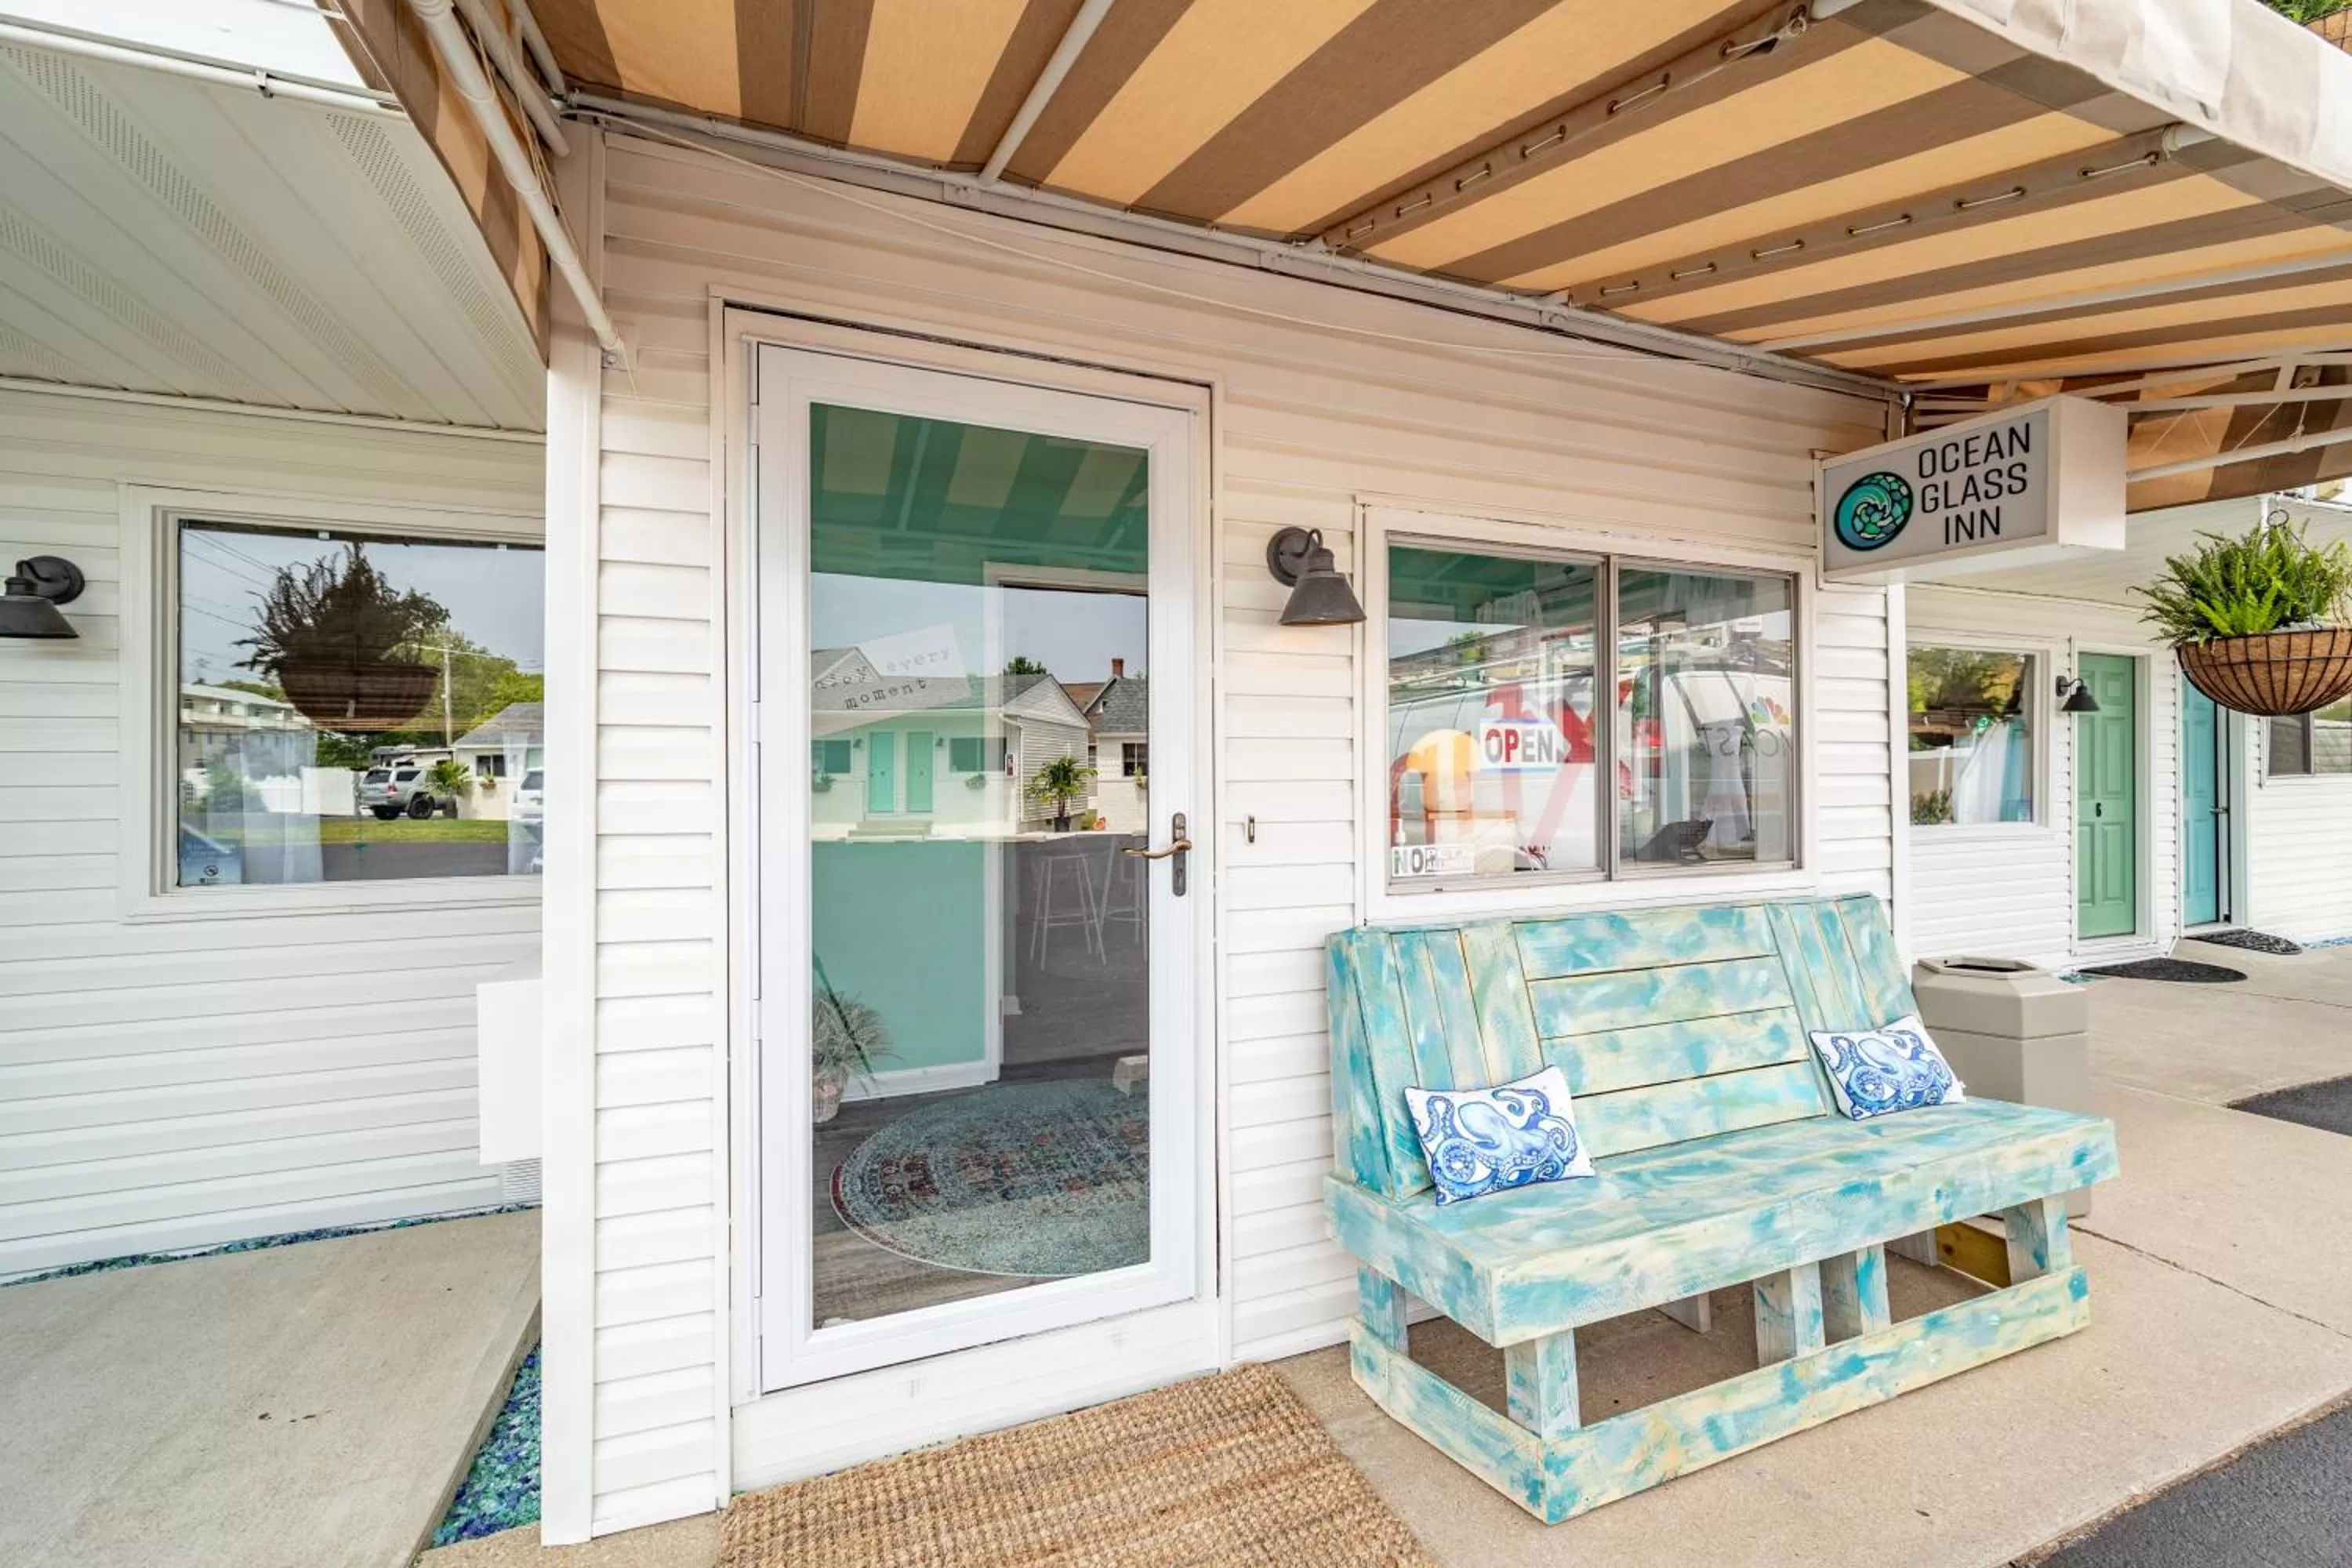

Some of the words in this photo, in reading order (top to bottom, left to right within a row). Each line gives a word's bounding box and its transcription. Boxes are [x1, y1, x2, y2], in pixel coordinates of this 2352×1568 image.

[1918, 422, 2031, 479] OCEAN
[1921, 462, 2027, 514] GLASS
[1944, 506, 2001, 545] INN
[844, 679, 927, 710] moment
[1484, 728, 1554, 764] OPEN
